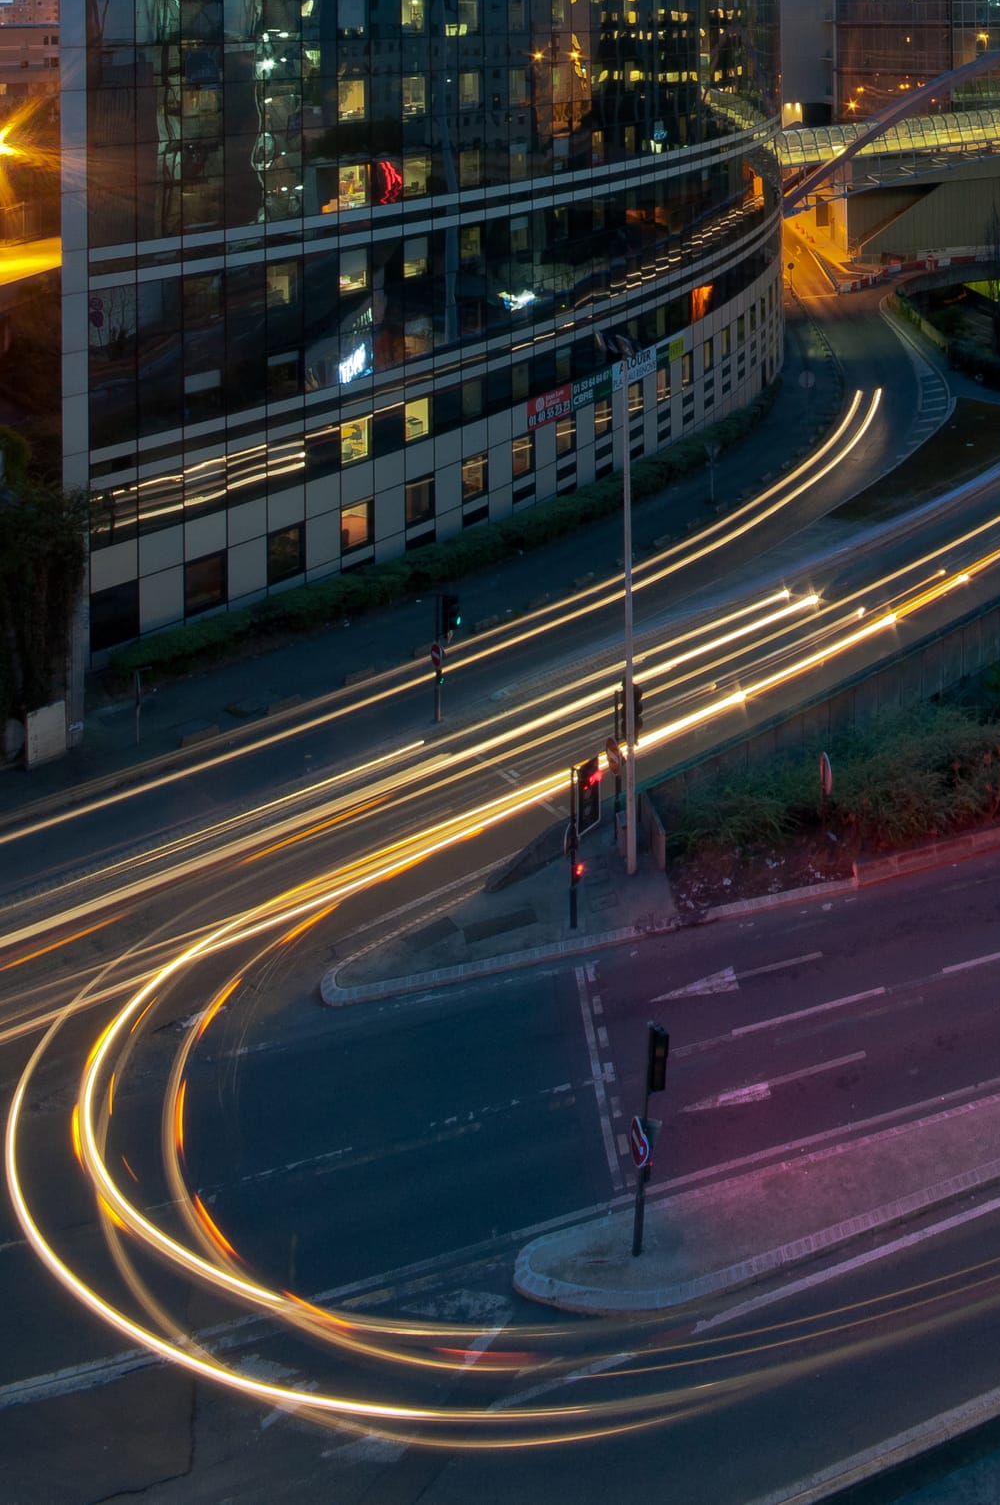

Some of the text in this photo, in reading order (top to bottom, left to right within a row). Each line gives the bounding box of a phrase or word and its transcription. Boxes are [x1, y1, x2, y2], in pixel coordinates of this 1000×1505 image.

[626, 349, 652, 370] LOUER
[573, 389, 593, 405] CBRE
[528, 415, 537, 427] 01
